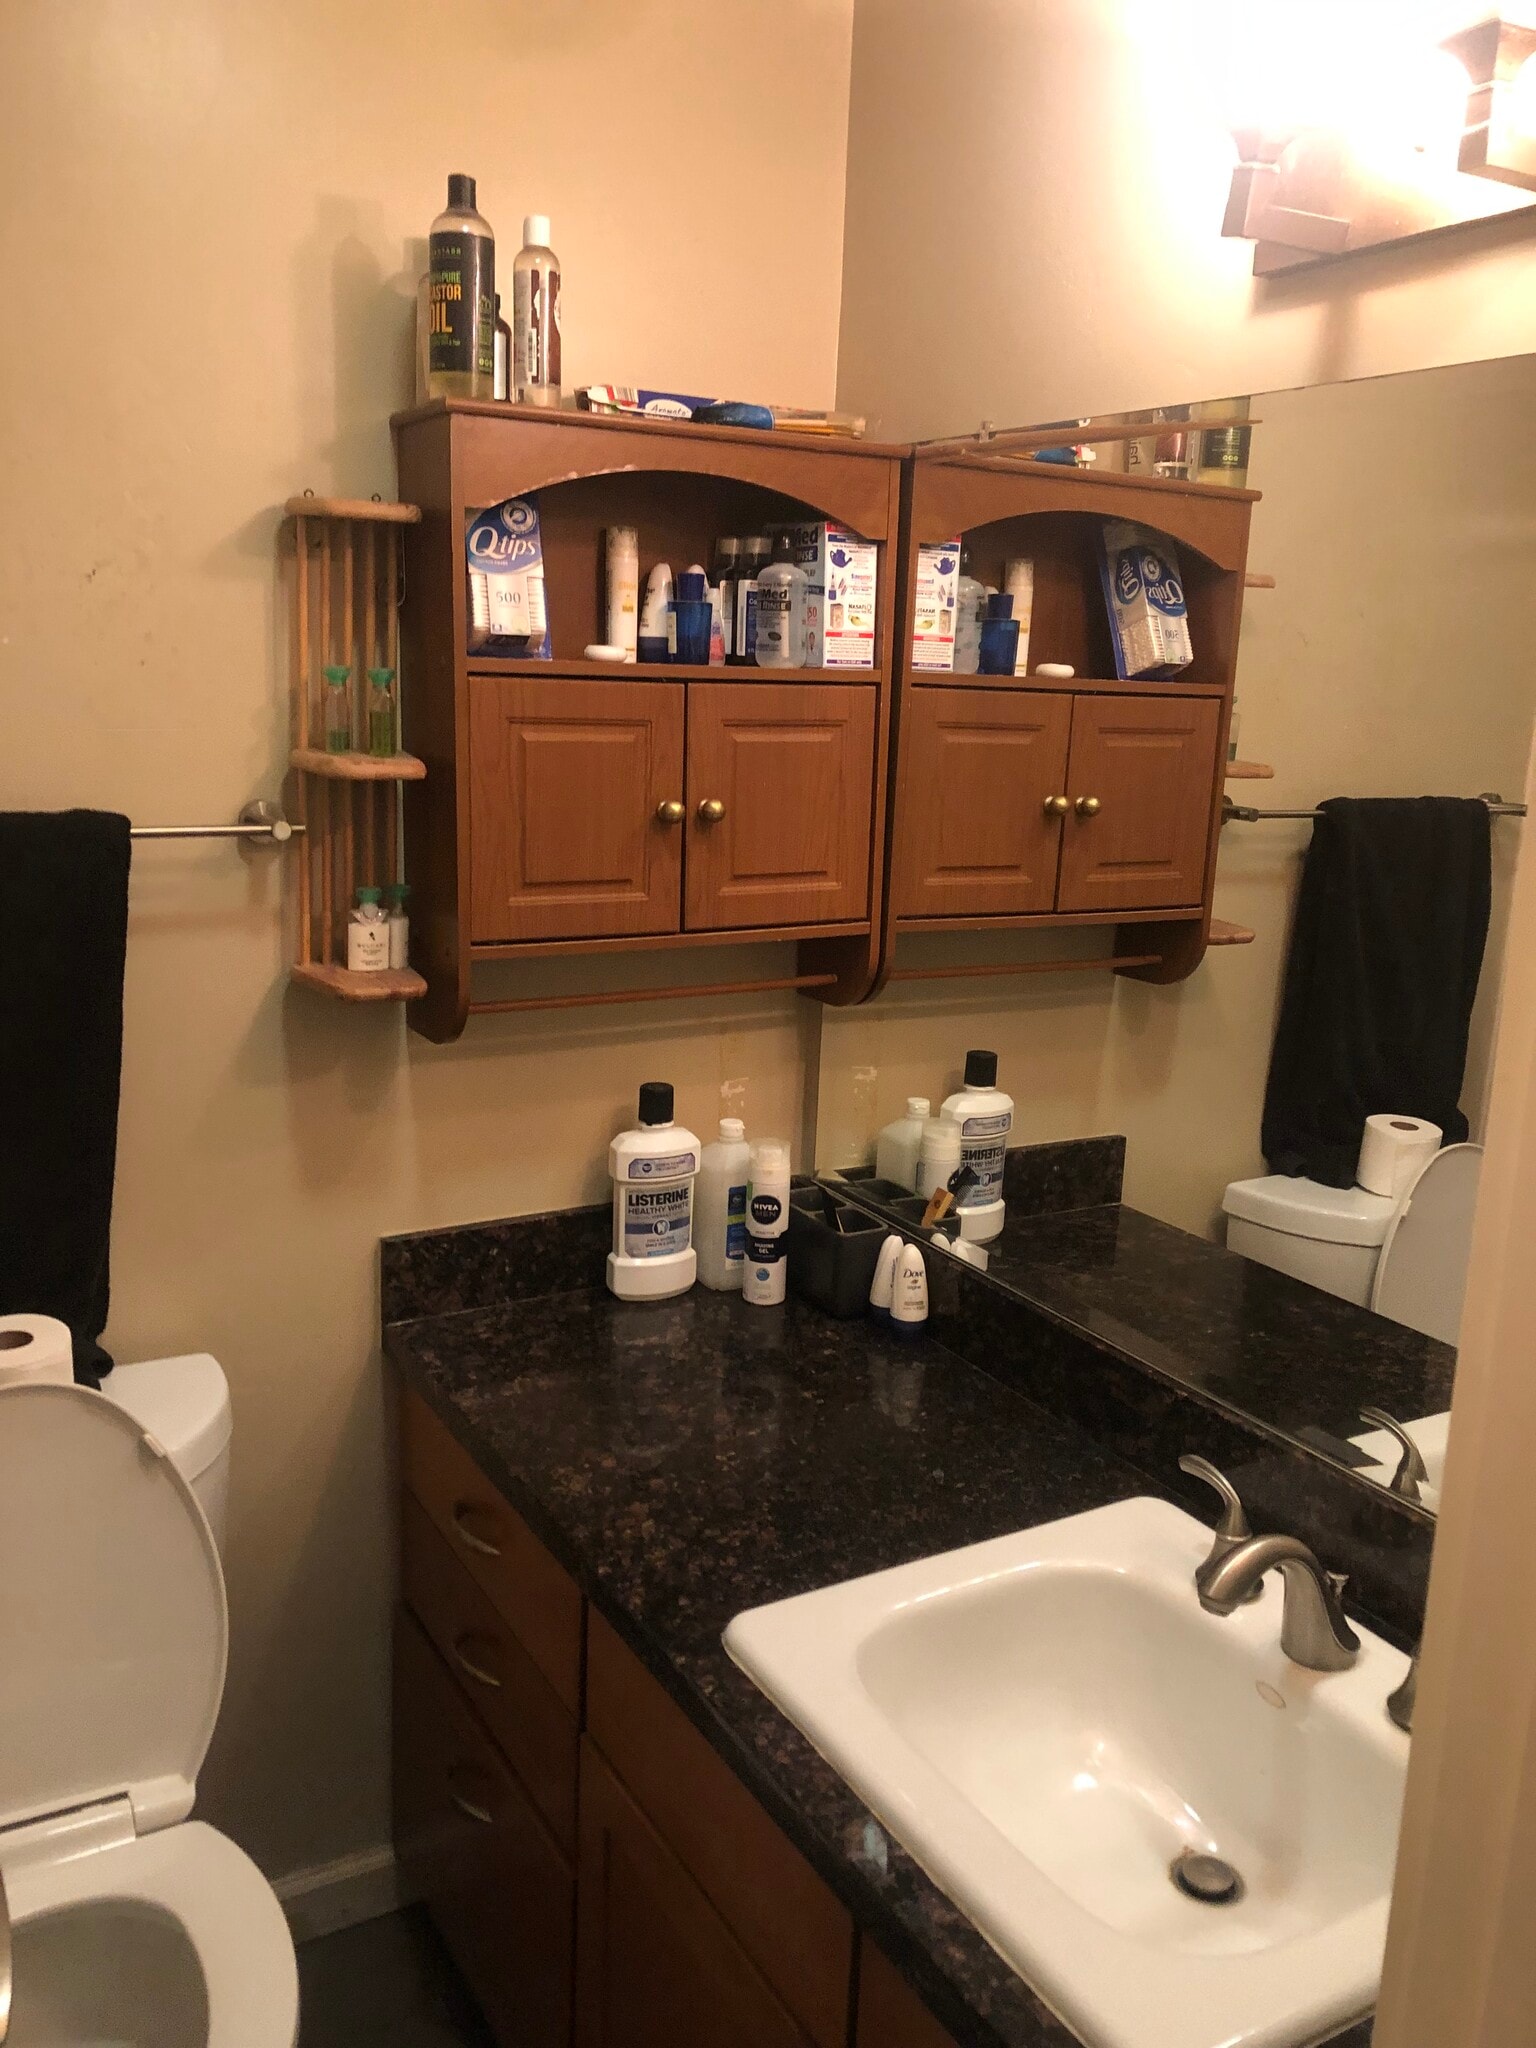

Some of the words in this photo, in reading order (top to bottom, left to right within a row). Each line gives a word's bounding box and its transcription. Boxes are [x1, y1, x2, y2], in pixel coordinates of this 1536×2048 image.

[496, 592, 521, 604] 500
[628, 1187, 689, 1206] LISTERINE
[628, 1206, 666, 1215] HEALTHY
[754, 1203, 778, 1211] NIVEA
[903, 1268, 924, 1279] Dove
